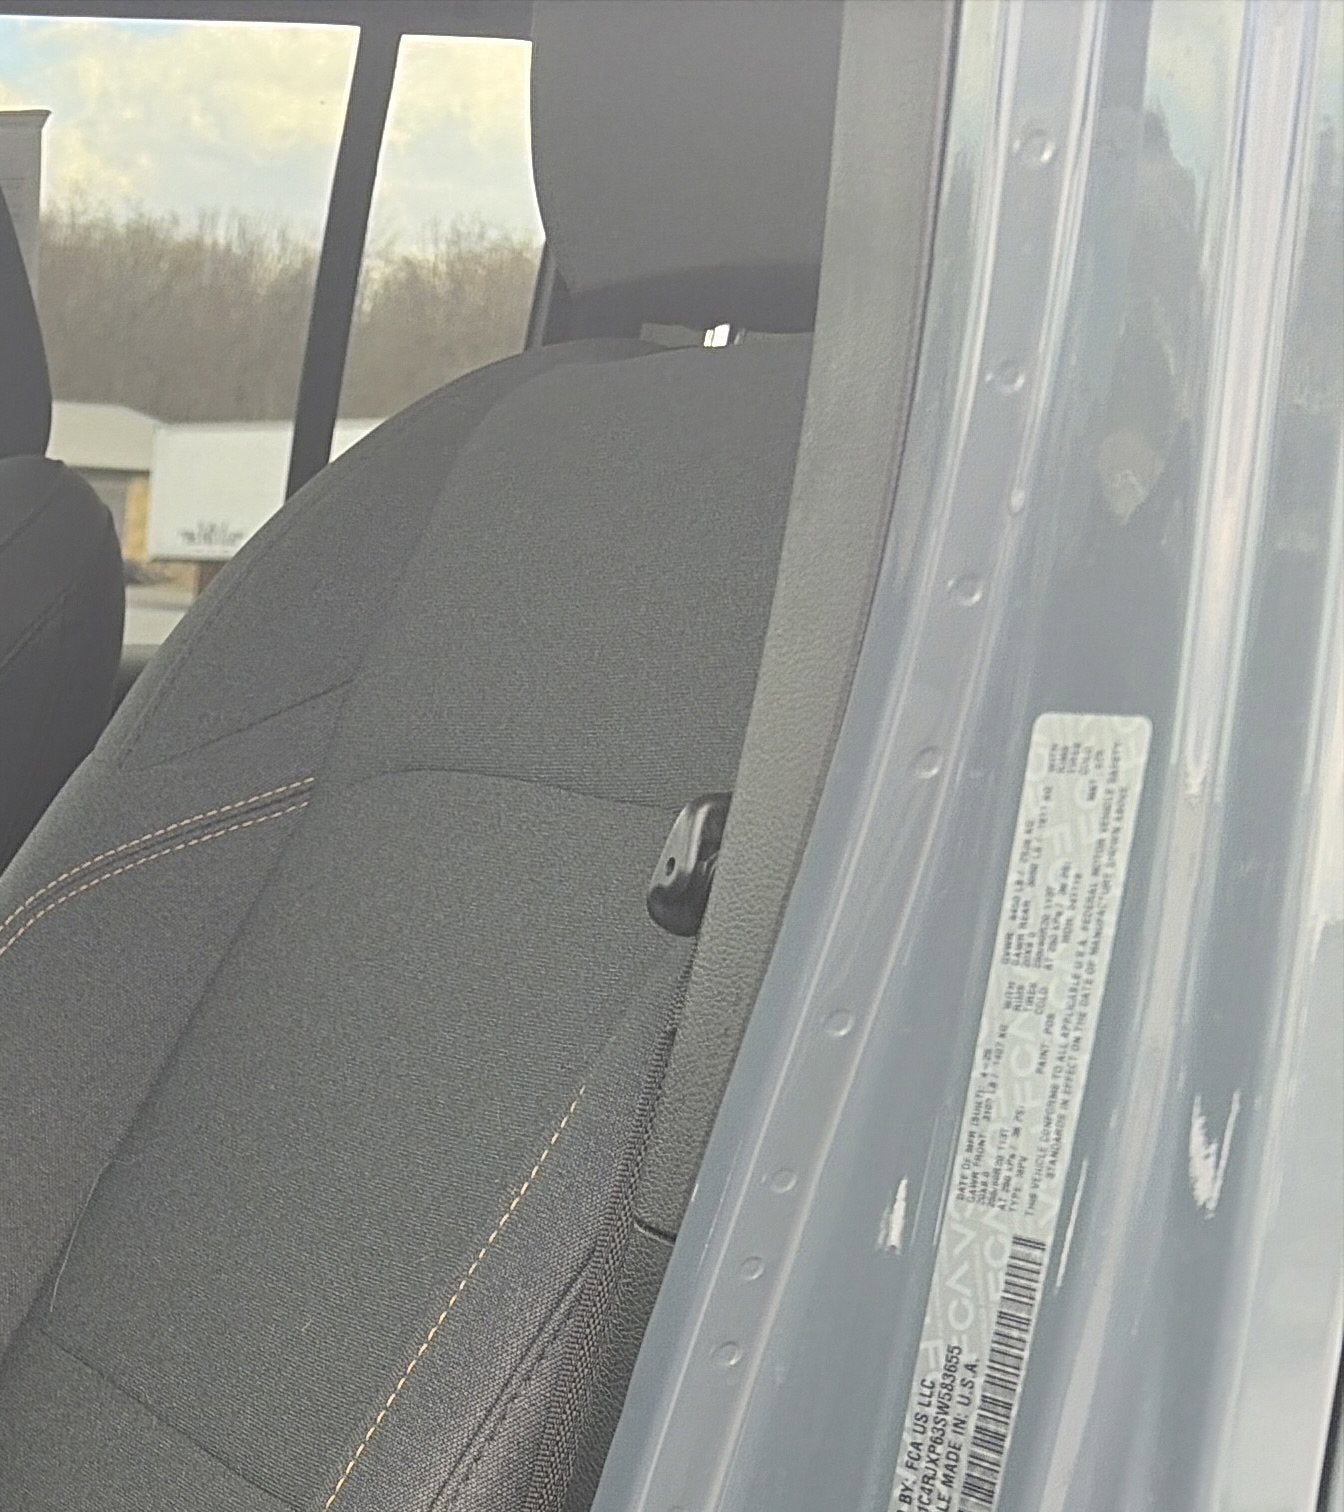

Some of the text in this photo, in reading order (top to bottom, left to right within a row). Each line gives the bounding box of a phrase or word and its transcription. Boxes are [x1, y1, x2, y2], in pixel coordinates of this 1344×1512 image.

[917, 1377, 935, 1408] LLC
[911, 1411, 928, 1435] US
[905, 1438, 923, 1471] FCA
[940, 1440, 962, 1489] MADE
[951, 1411, 967, 1436] IN:
[897, 1476, 916, 1505] BY:
